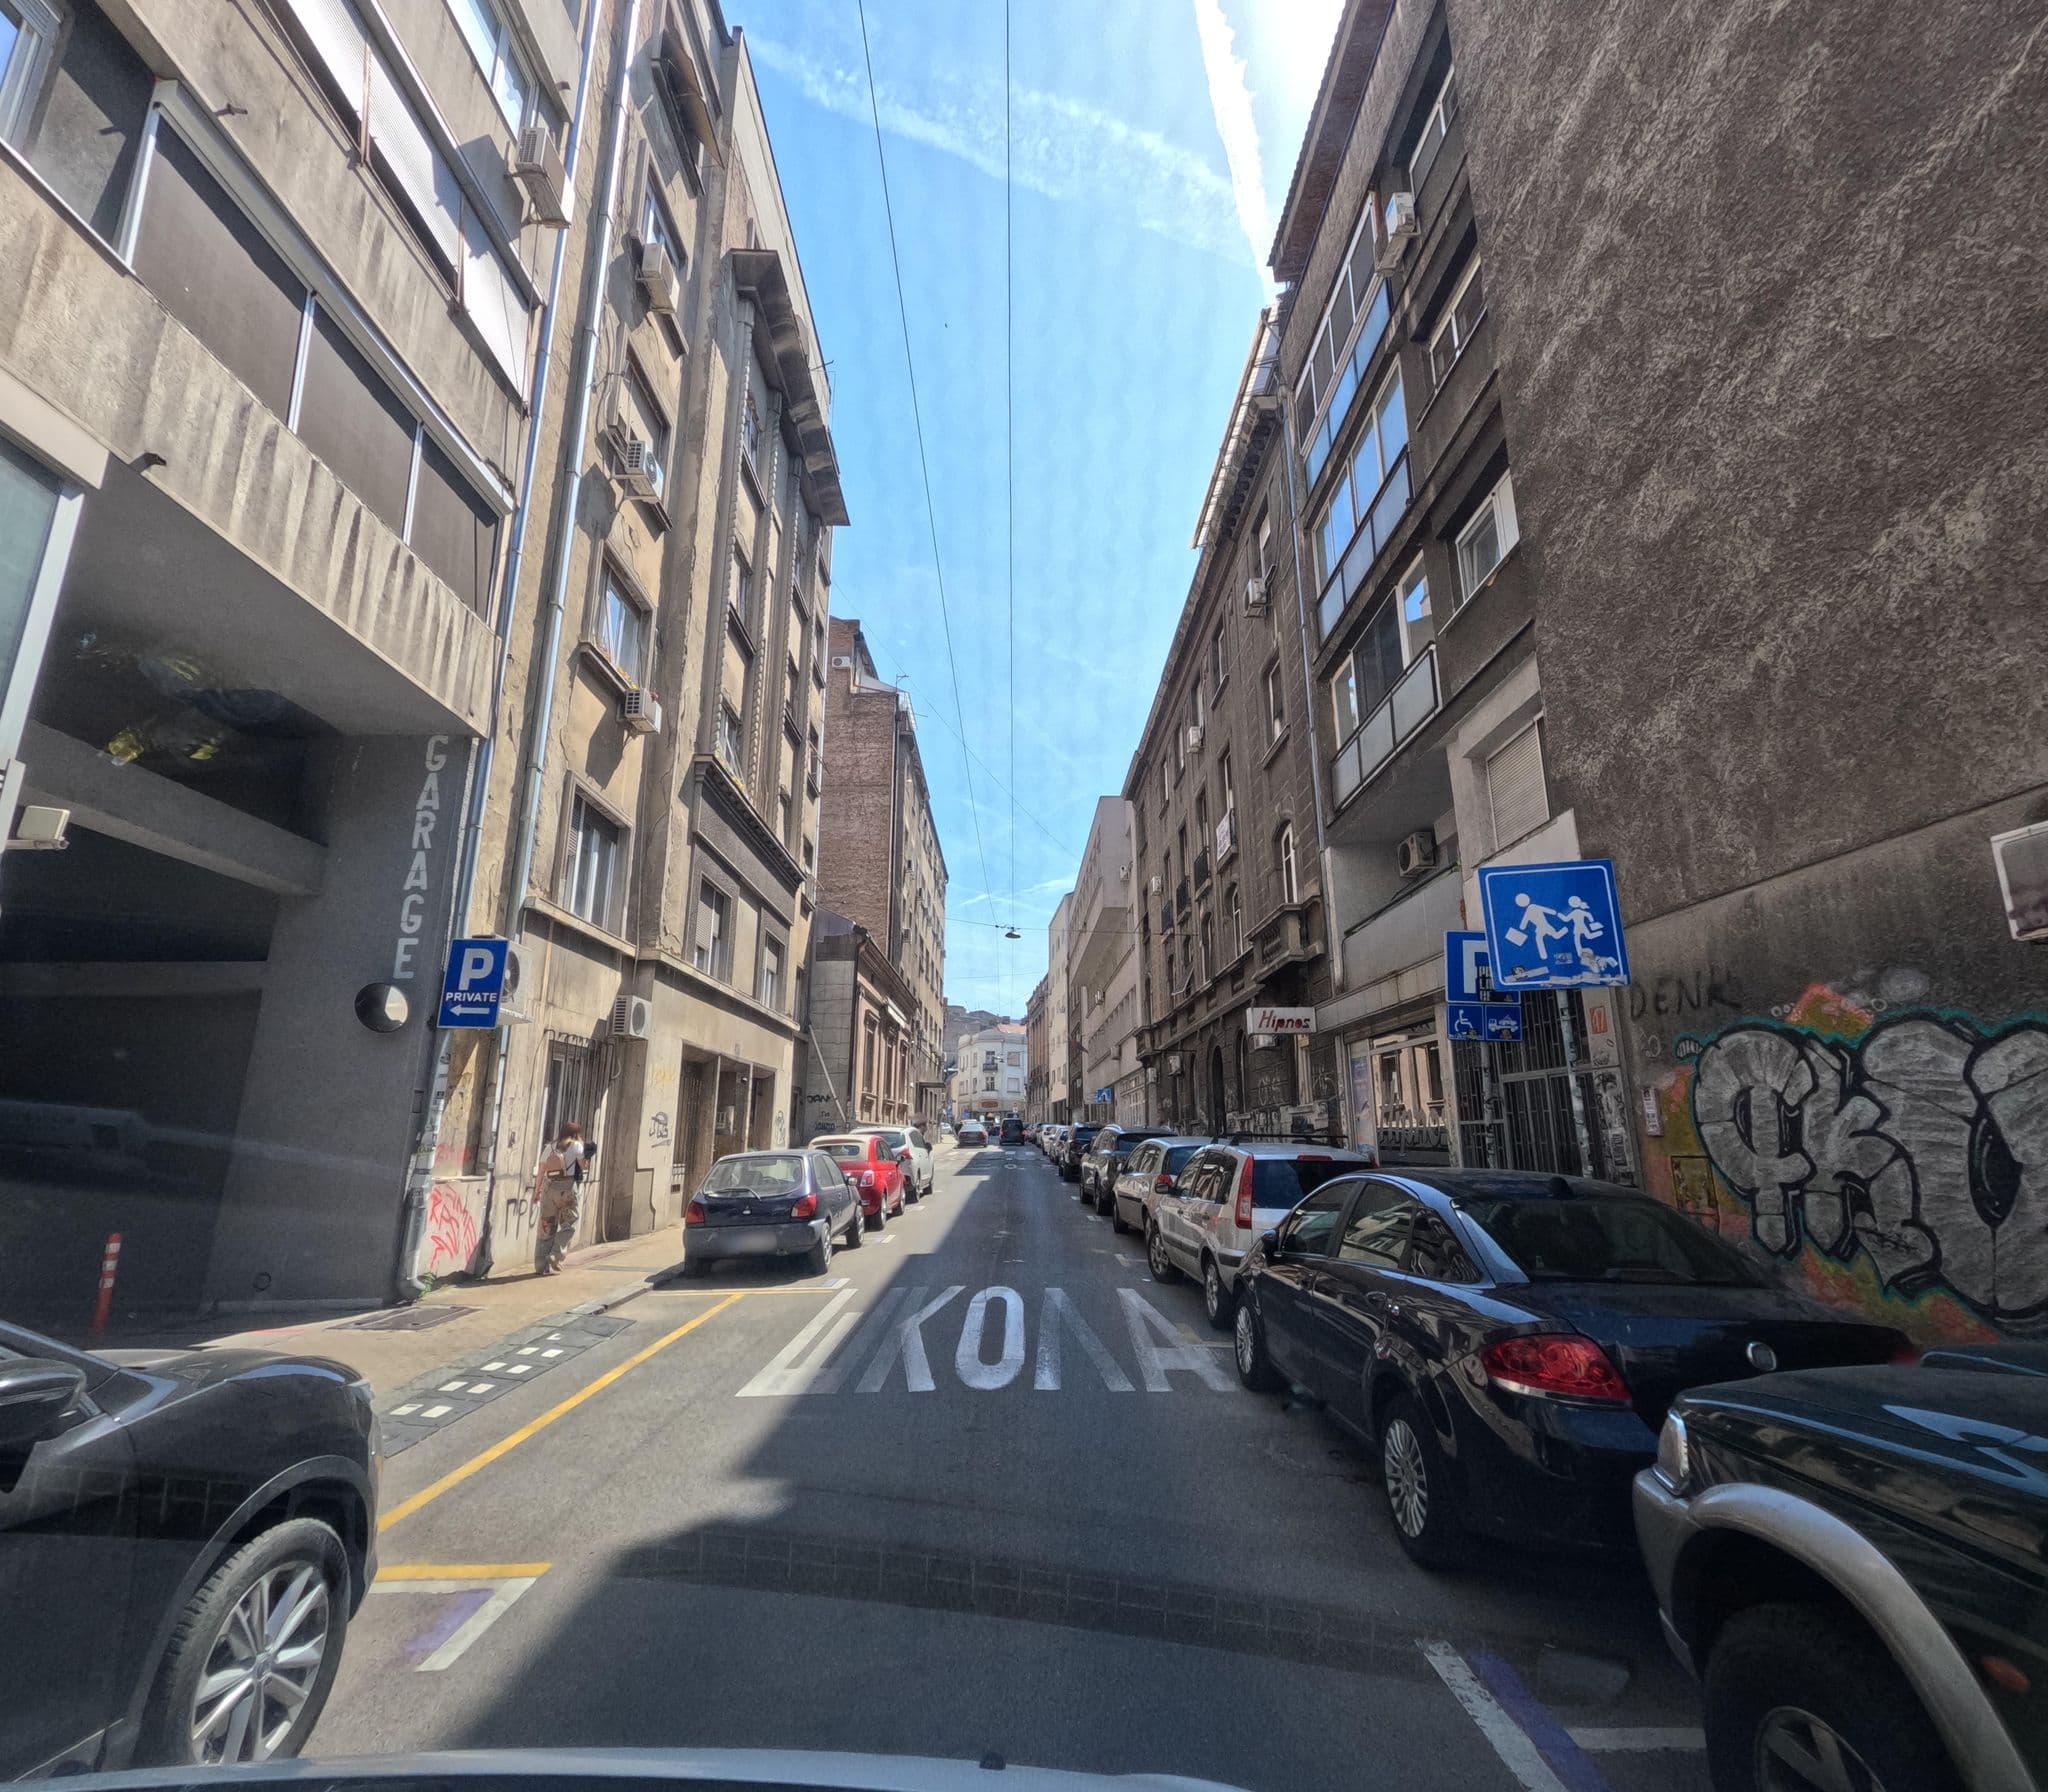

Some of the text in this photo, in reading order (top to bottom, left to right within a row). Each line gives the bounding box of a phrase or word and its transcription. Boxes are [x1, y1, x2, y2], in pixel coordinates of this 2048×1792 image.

[394, 735, 448, 979] GARAGE
[458, 948, 494, 991] P
[445, 992, 497, 1003] PRIVATE
[1259, 1009, 1311, 1032] Hipnos
[735, 1284, 1236, 1397] ШКОЛА
